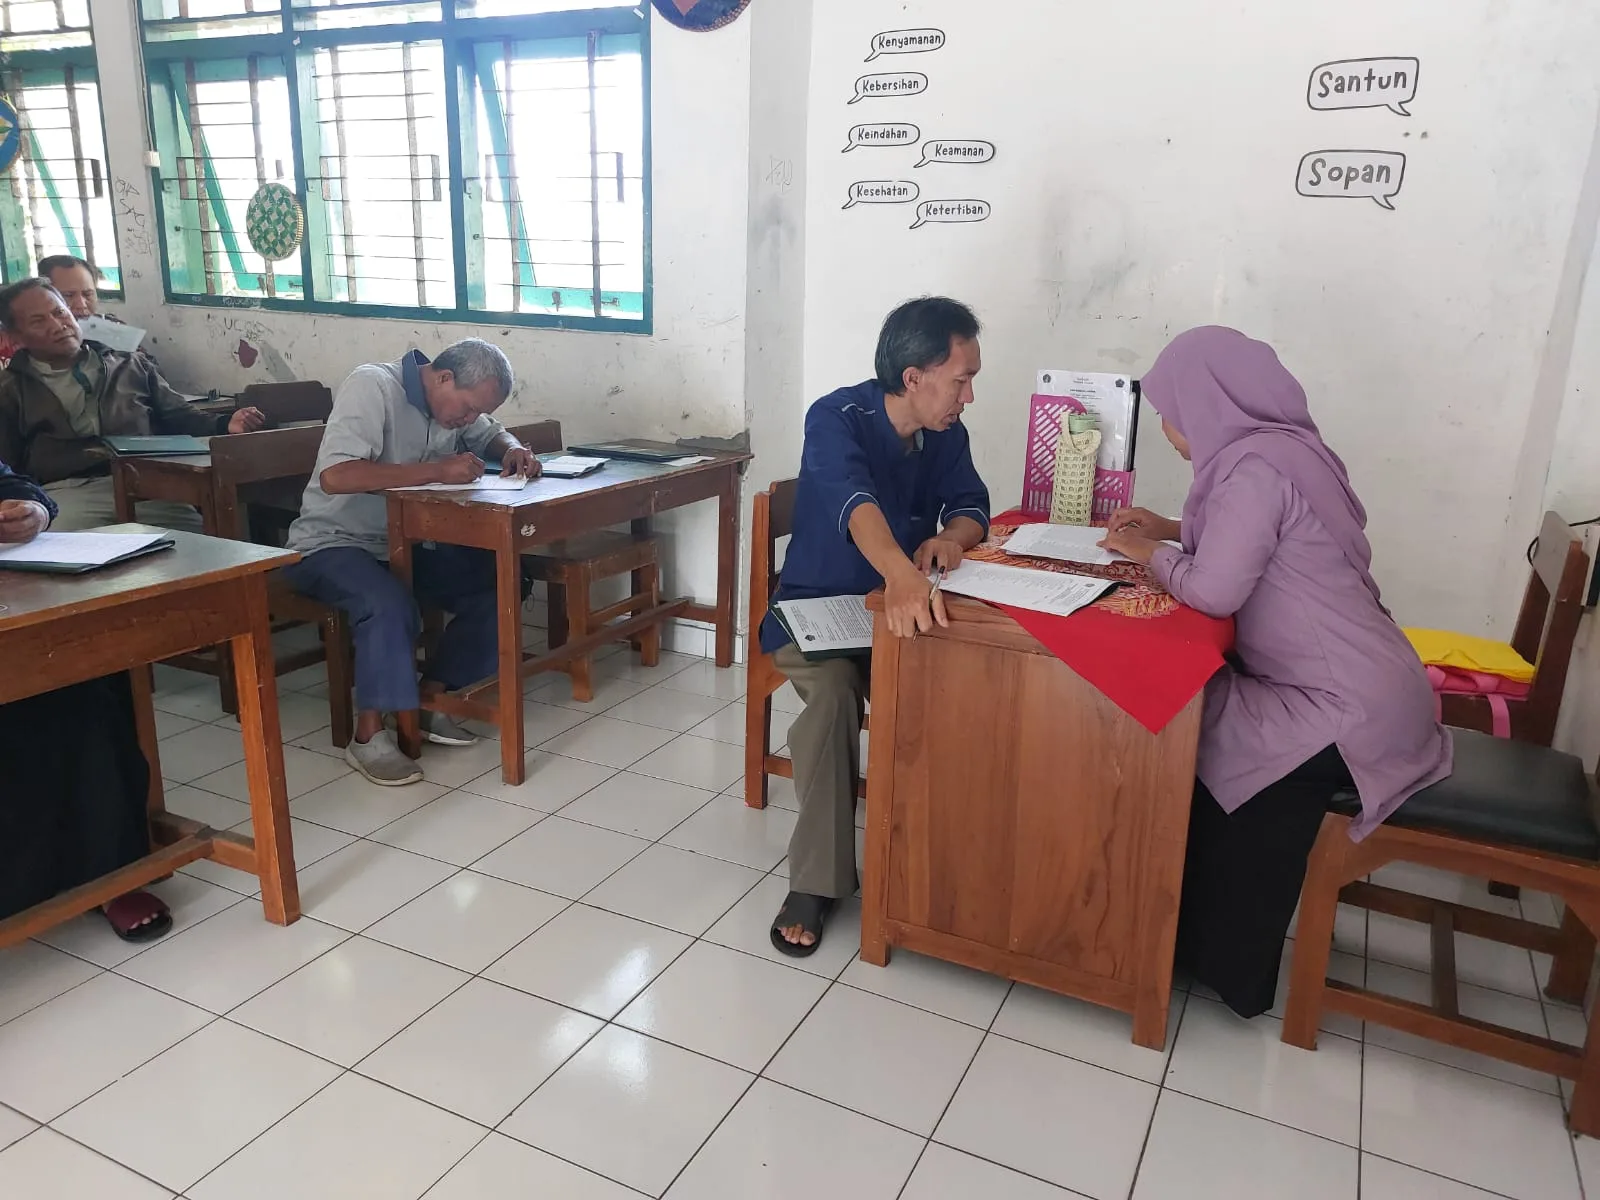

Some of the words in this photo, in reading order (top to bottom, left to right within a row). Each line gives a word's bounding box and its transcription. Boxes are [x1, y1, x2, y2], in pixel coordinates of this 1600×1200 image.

[878, 34, 941, 49] Kenyamanan
[862, 78, 919, 93] Kebersihan
[1317, 68, 1407, 98] Santun
[857, 127, 908, 142] Keindahan
[934, 143, 985, 158] Keamanan
[1308, 157, 1391, 190] Sopan
[856, 184, 909, 198] Kesehatan
[925, 203, 984, 217] Ketertiban
